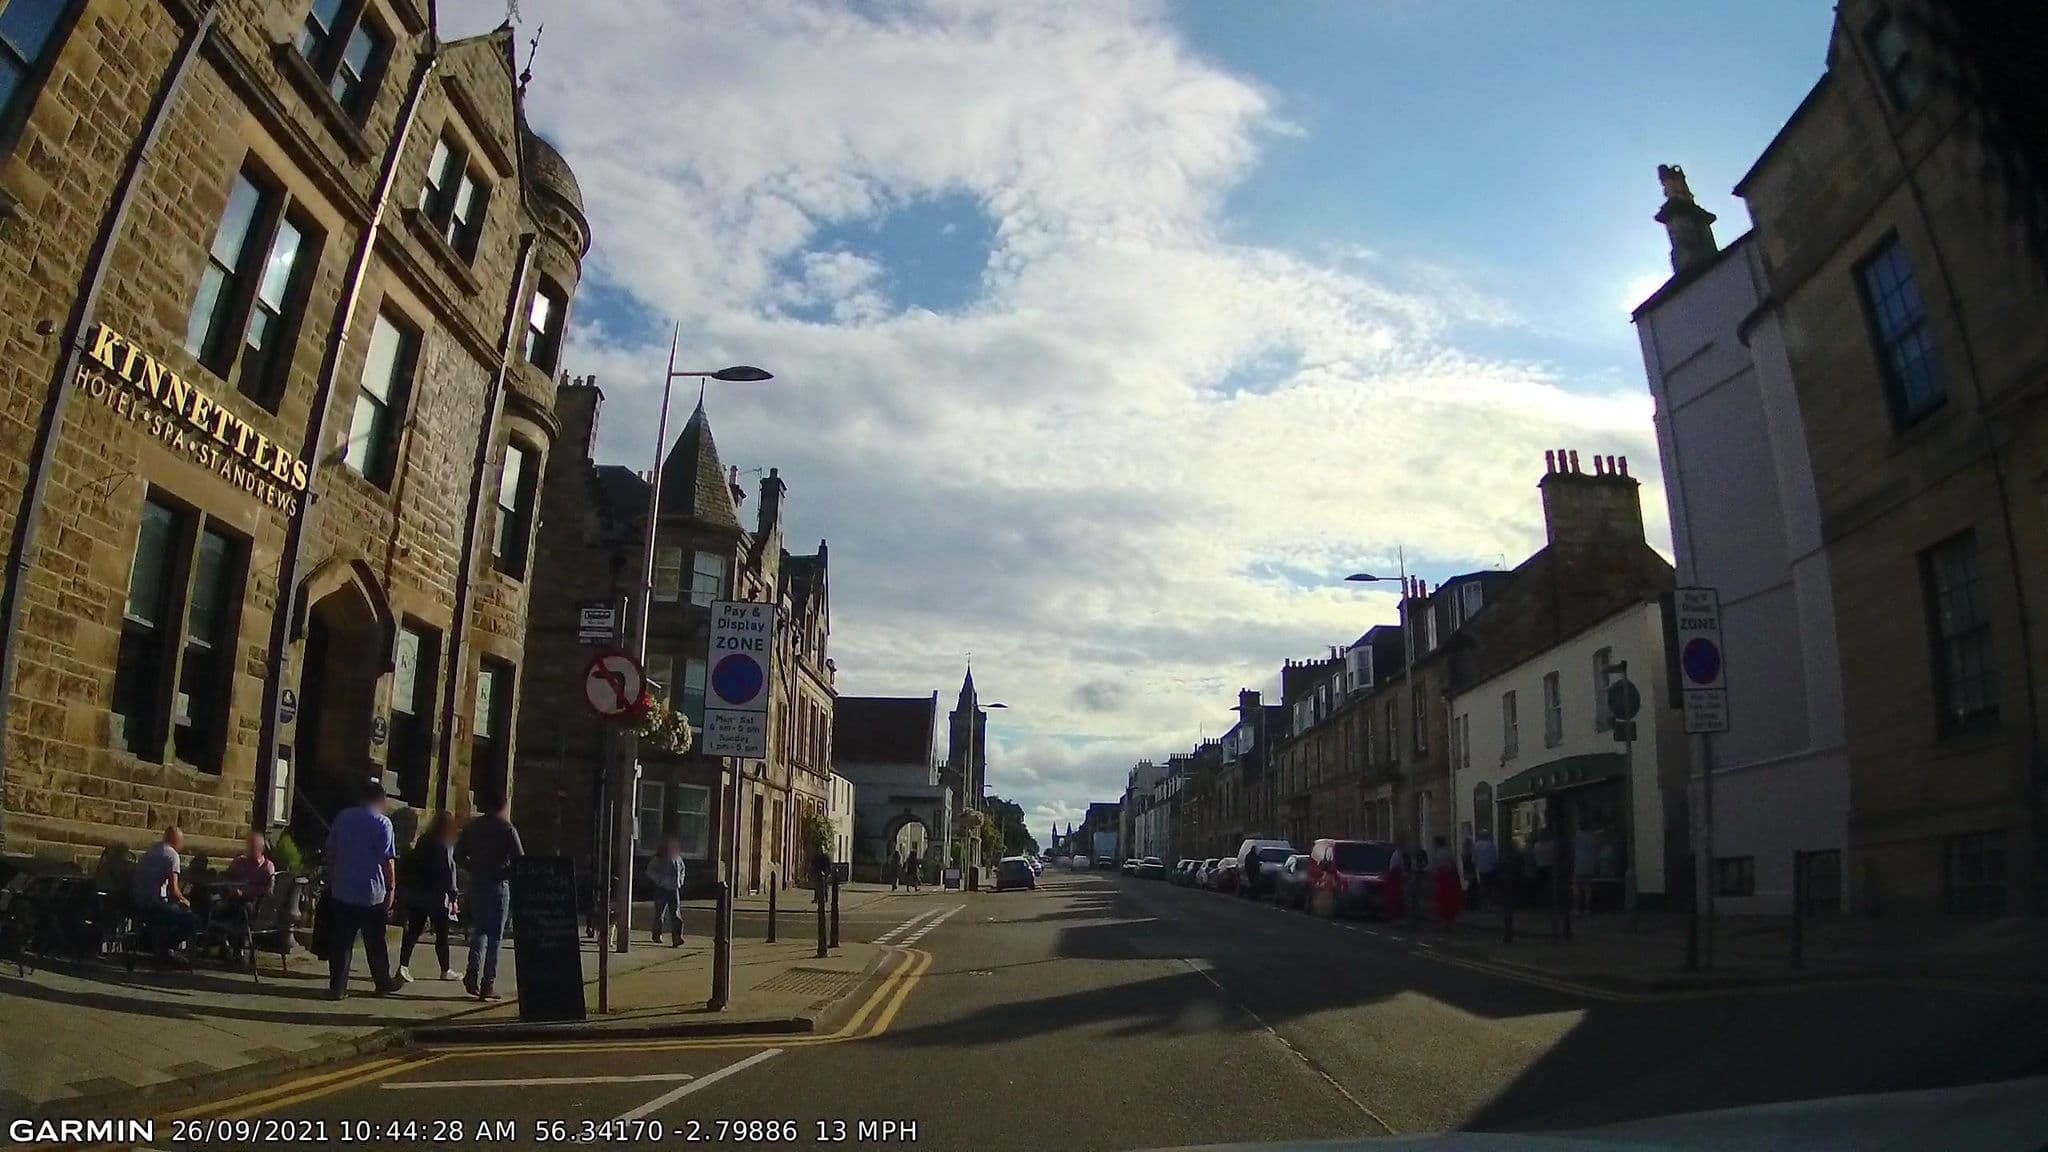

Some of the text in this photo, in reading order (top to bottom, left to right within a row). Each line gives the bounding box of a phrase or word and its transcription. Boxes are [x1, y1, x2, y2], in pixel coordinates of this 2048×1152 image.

[76, 364, 137, 422] HOTEL
[152, 415, 184, 450] SPA
[88, 321, 309, 492] KINNETTLES
[724, 605, 760, 619] Pay &
[718, 619, 765, 633] Display
[716, 636, 764, 651] ZONE
